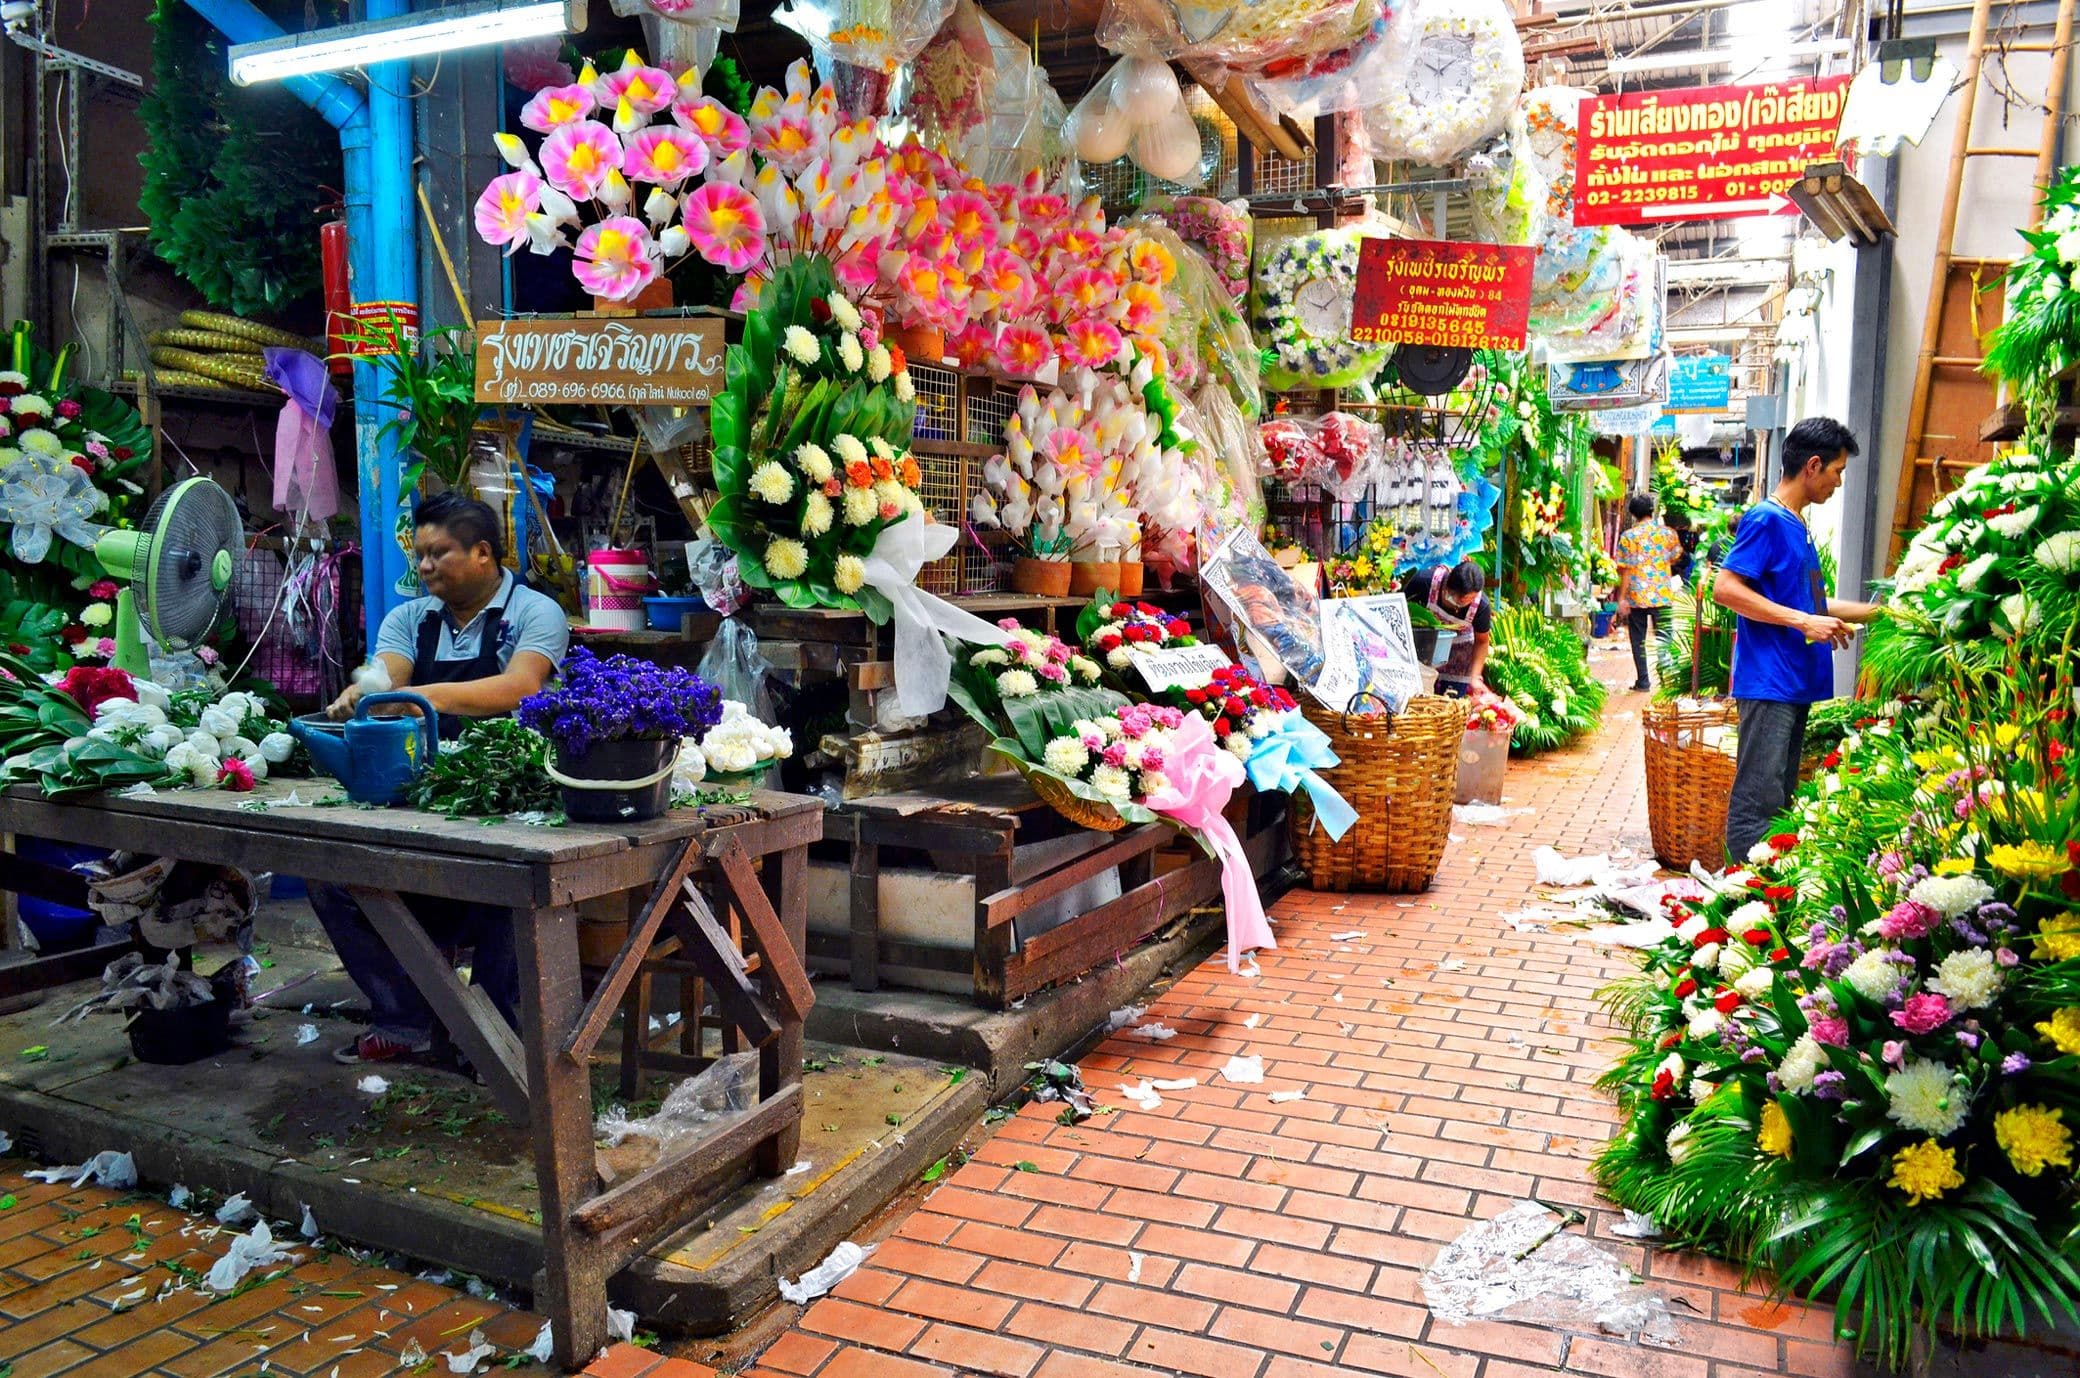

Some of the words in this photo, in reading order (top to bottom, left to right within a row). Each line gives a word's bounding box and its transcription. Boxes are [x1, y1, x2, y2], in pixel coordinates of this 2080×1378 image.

[1589, 132, 1740, 161] รับจัดดอกไม้
[1651, 168, 1694, 183] และ
[1587, 185, 1699, 206] 02-2239815
[482, 320, 724, 391] รุ่งเพชรเจริญพร
